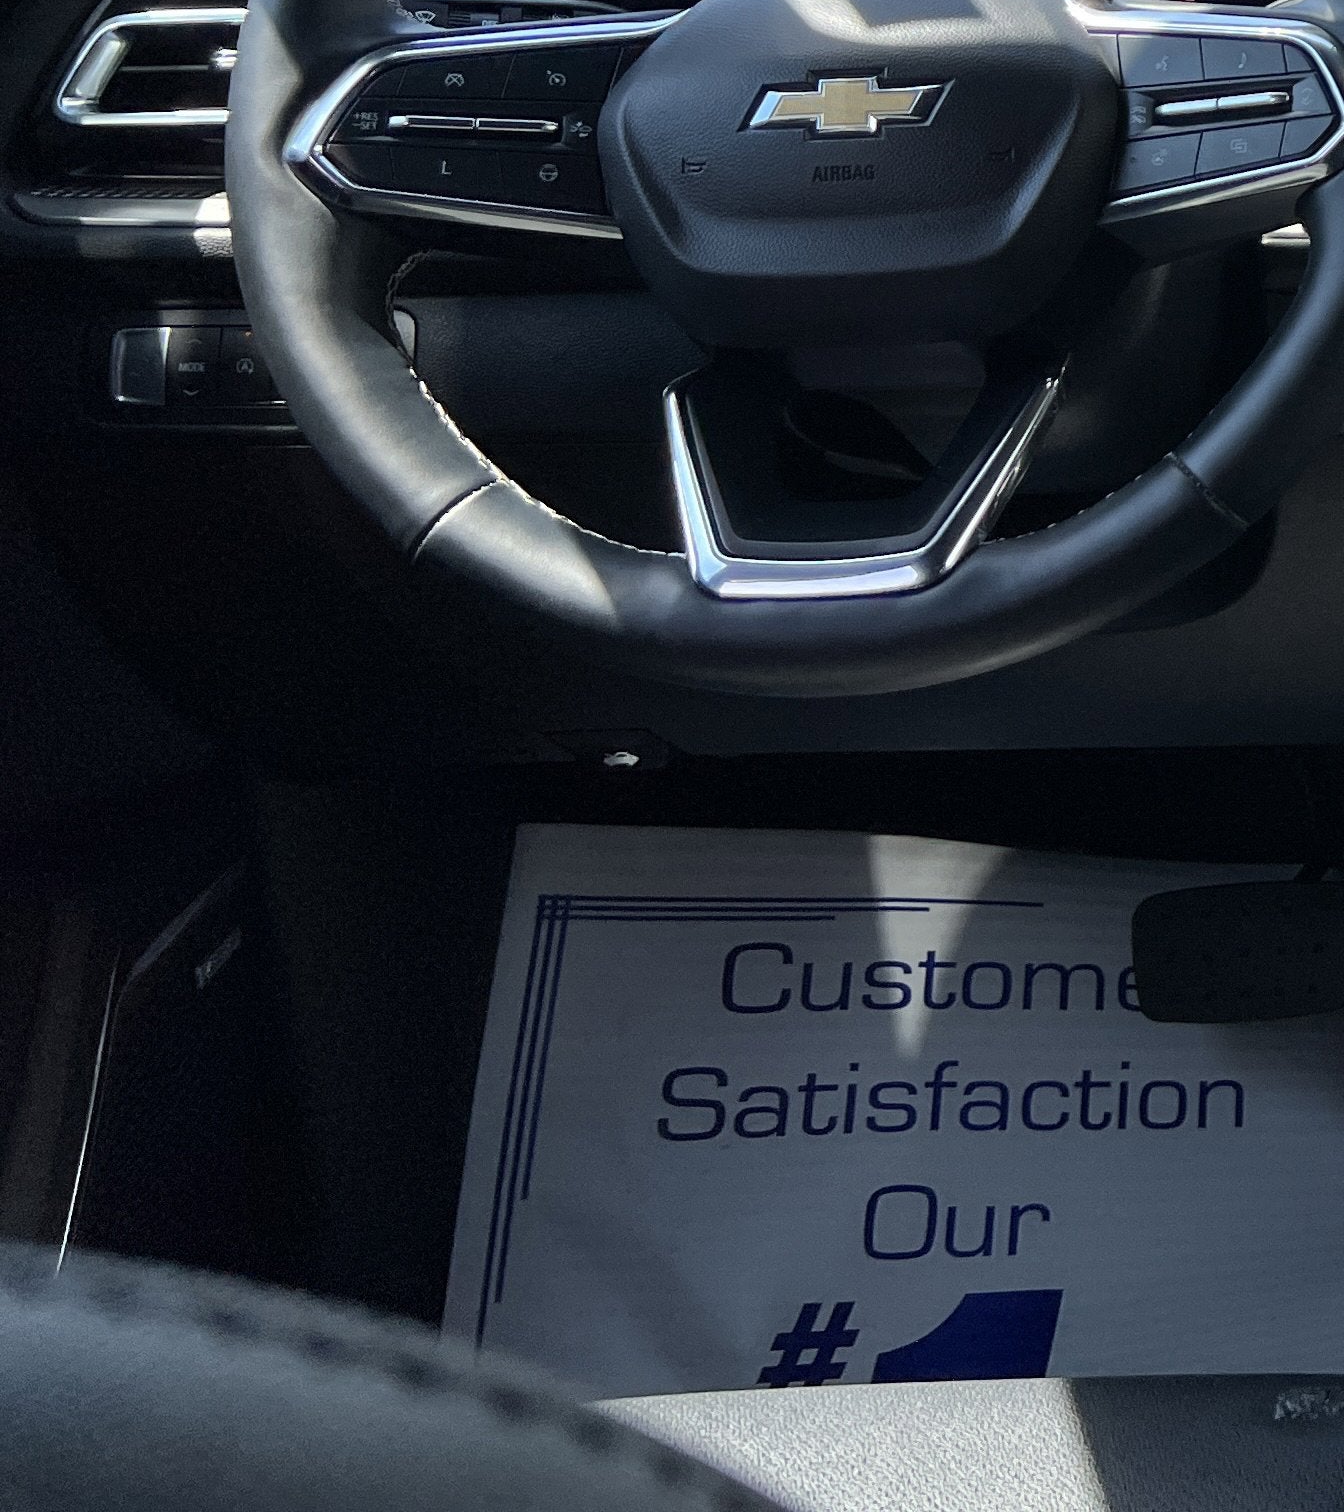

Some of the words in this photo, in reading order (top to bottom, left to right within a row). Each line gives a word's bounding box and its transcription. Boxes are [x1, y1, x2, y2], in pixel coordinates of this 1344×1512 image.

[813, 166, 876, 181] AIRBAG
[657, 1060, 1246, 1142] Satisfaction
[863, 1184, 1051, 1261] Our
